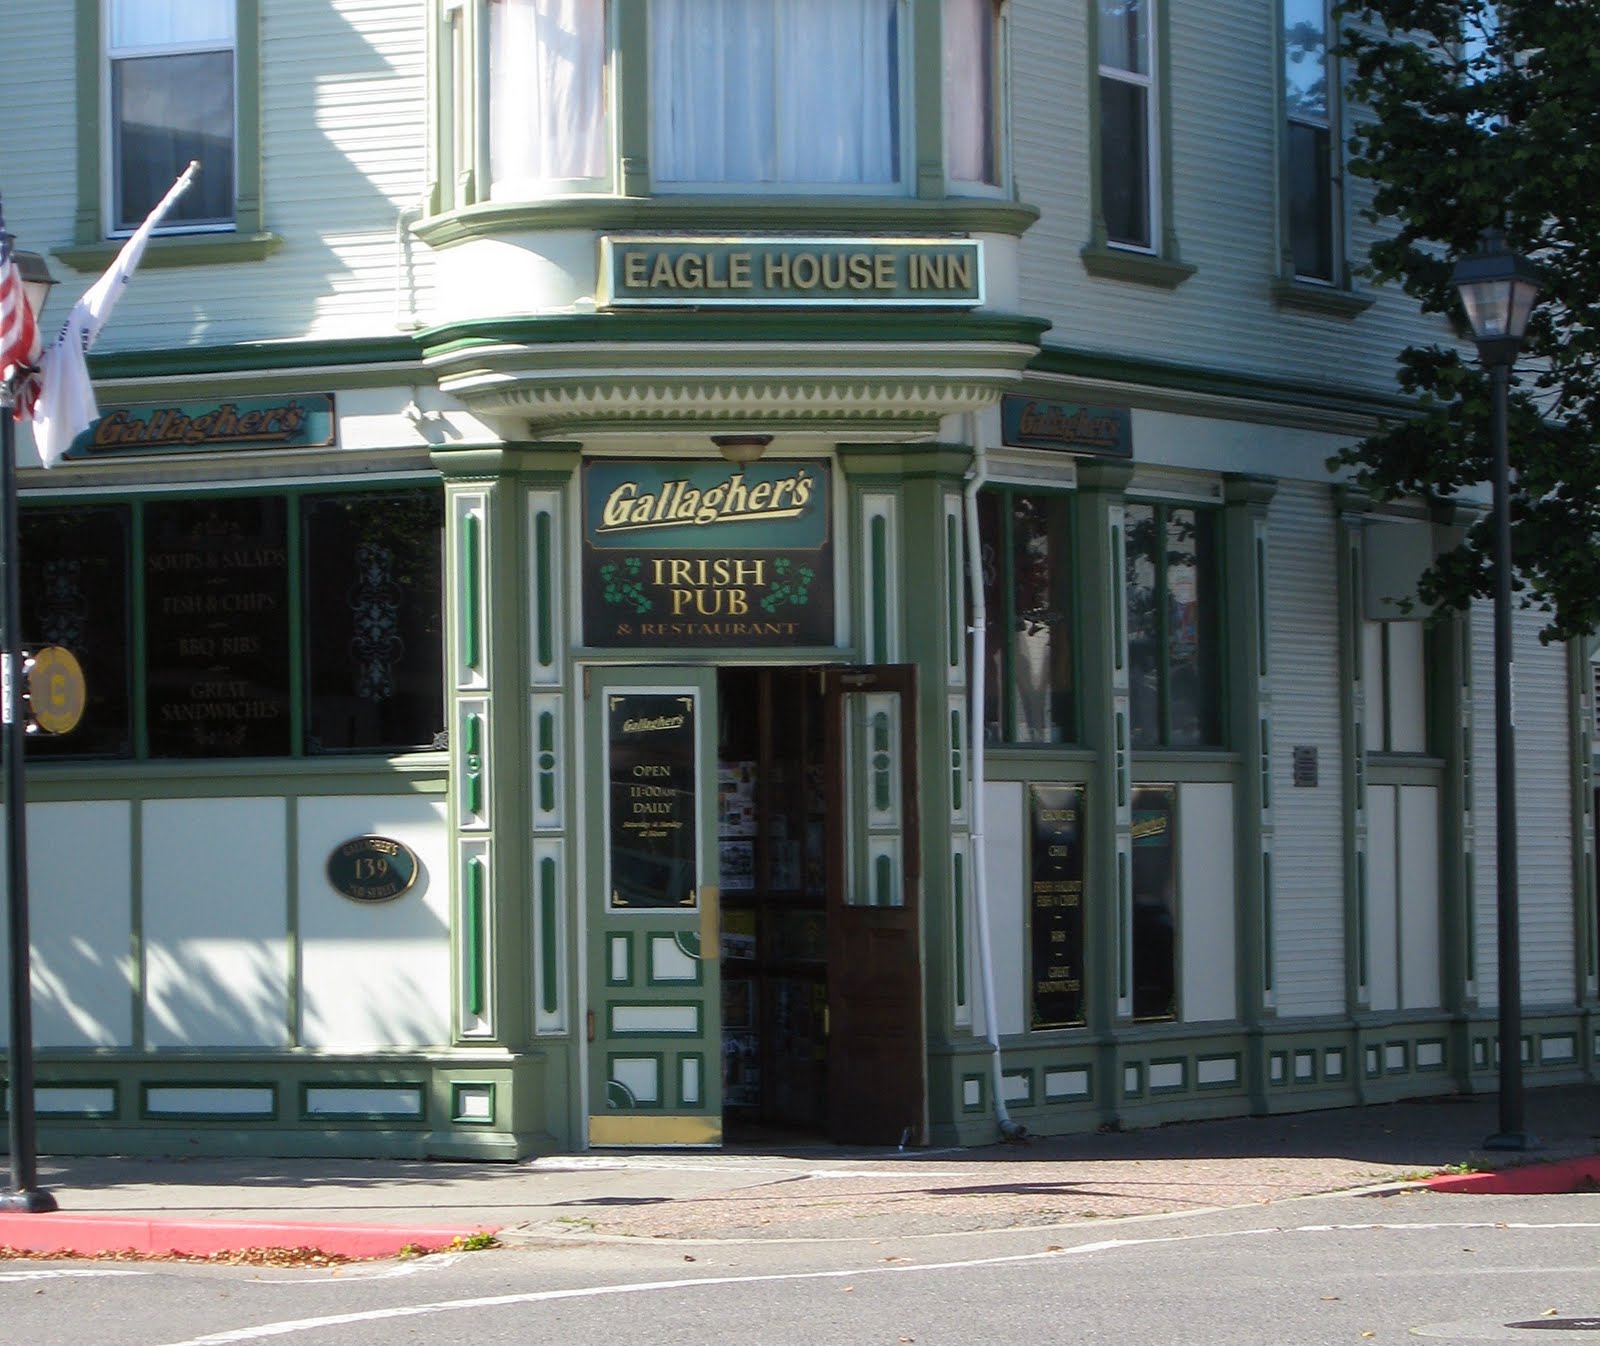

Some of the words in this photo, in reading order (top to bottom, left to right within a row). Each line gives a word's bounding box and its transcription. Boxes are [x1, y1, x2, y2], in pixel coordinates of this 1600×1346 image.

[624, 252, 753, 288] EAGLE
[764, 253, 897, 289] HOUSE
[908, 254, 972, 288] INN
[94, 401, 306, 445] Gallagher's
[602, 468, 814, 525] Gallagher's
[148, 552, 203, 570] SOUPS
[223, 549, 288, 569] SALADS
[651, 557, 766, 587] IRISH
[671, 587, 750, 615] PUB
[617, 623, 632, 636] &
[640, 622, 800, 636] RESTAURANT
[178, 637, 217, 656] BBQ
[190, 682, 249, 699] GREAT
[160, 703, 281, 721] SANDWICHES
[632, 765, 671, 777] OPEN
[632, 802, 673, 814] DAILY
[354, 858, 388, 880] 139
